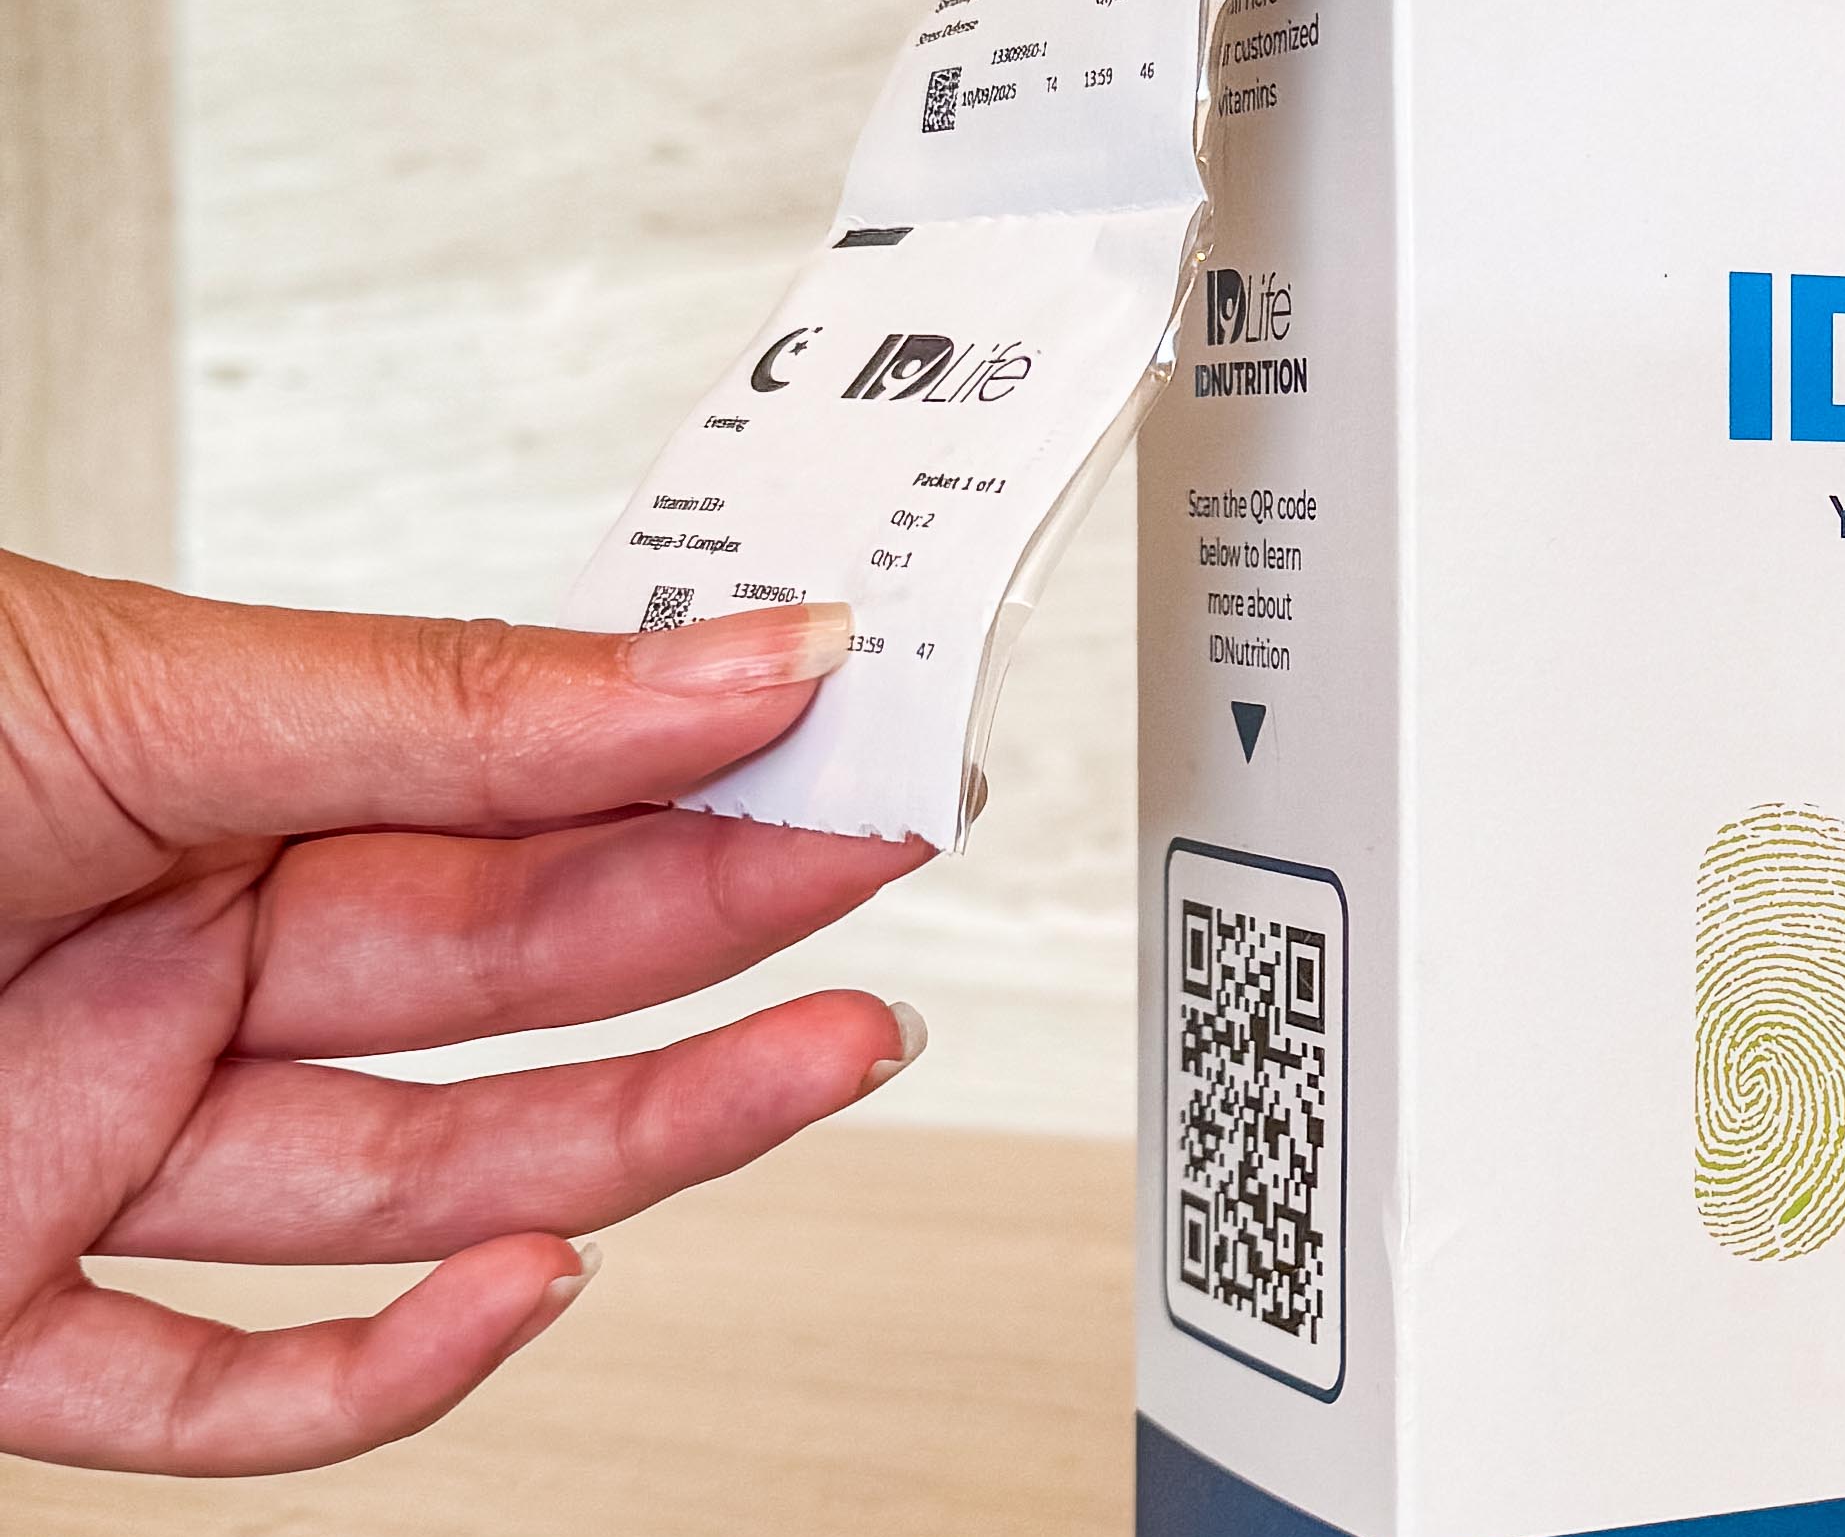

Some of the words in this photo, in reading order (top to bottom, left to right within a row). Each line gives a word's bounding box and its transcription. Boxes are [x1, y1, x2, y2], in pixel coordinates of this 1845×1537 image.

[1235, 13, 1318, 63] customized
[1084, 67, 1113, 88] 13:59
[1140, 62, 1155, 79] 46
[1218, 78, 1277, 118] vitamins
[1195, 358, 1307, 397] IDNUTRITION
[912, 472, 960, 490] Packet
[961, 476, 973, 491] 1
[976, 478, 996, 493] of
[994, 480, 1006, 494] 1
[653, 495, 699, 511] Vitamin
[1189, 489, 1220, 518] Scan
[1223, 488, 1247, 518] the
[1250, 489, 1274, 524] QR
[1277, 488, 1317, 520] code
[630, 531, 687, 550] Omega-3
[686, 535, 742, 554] Complex
[1200, 536, 1241, 567] below
[1244, 542, 1259, 568] to
[1263, 538, 1301, 571] learn
[1208, 592, 1243, 616] more
[1247, 588, 1292, 620] about
[847, 635, 885, 654] 13:59
[916, 643, 935, 660] 47
[1210, 634, 1290, 670] IDNutrition
